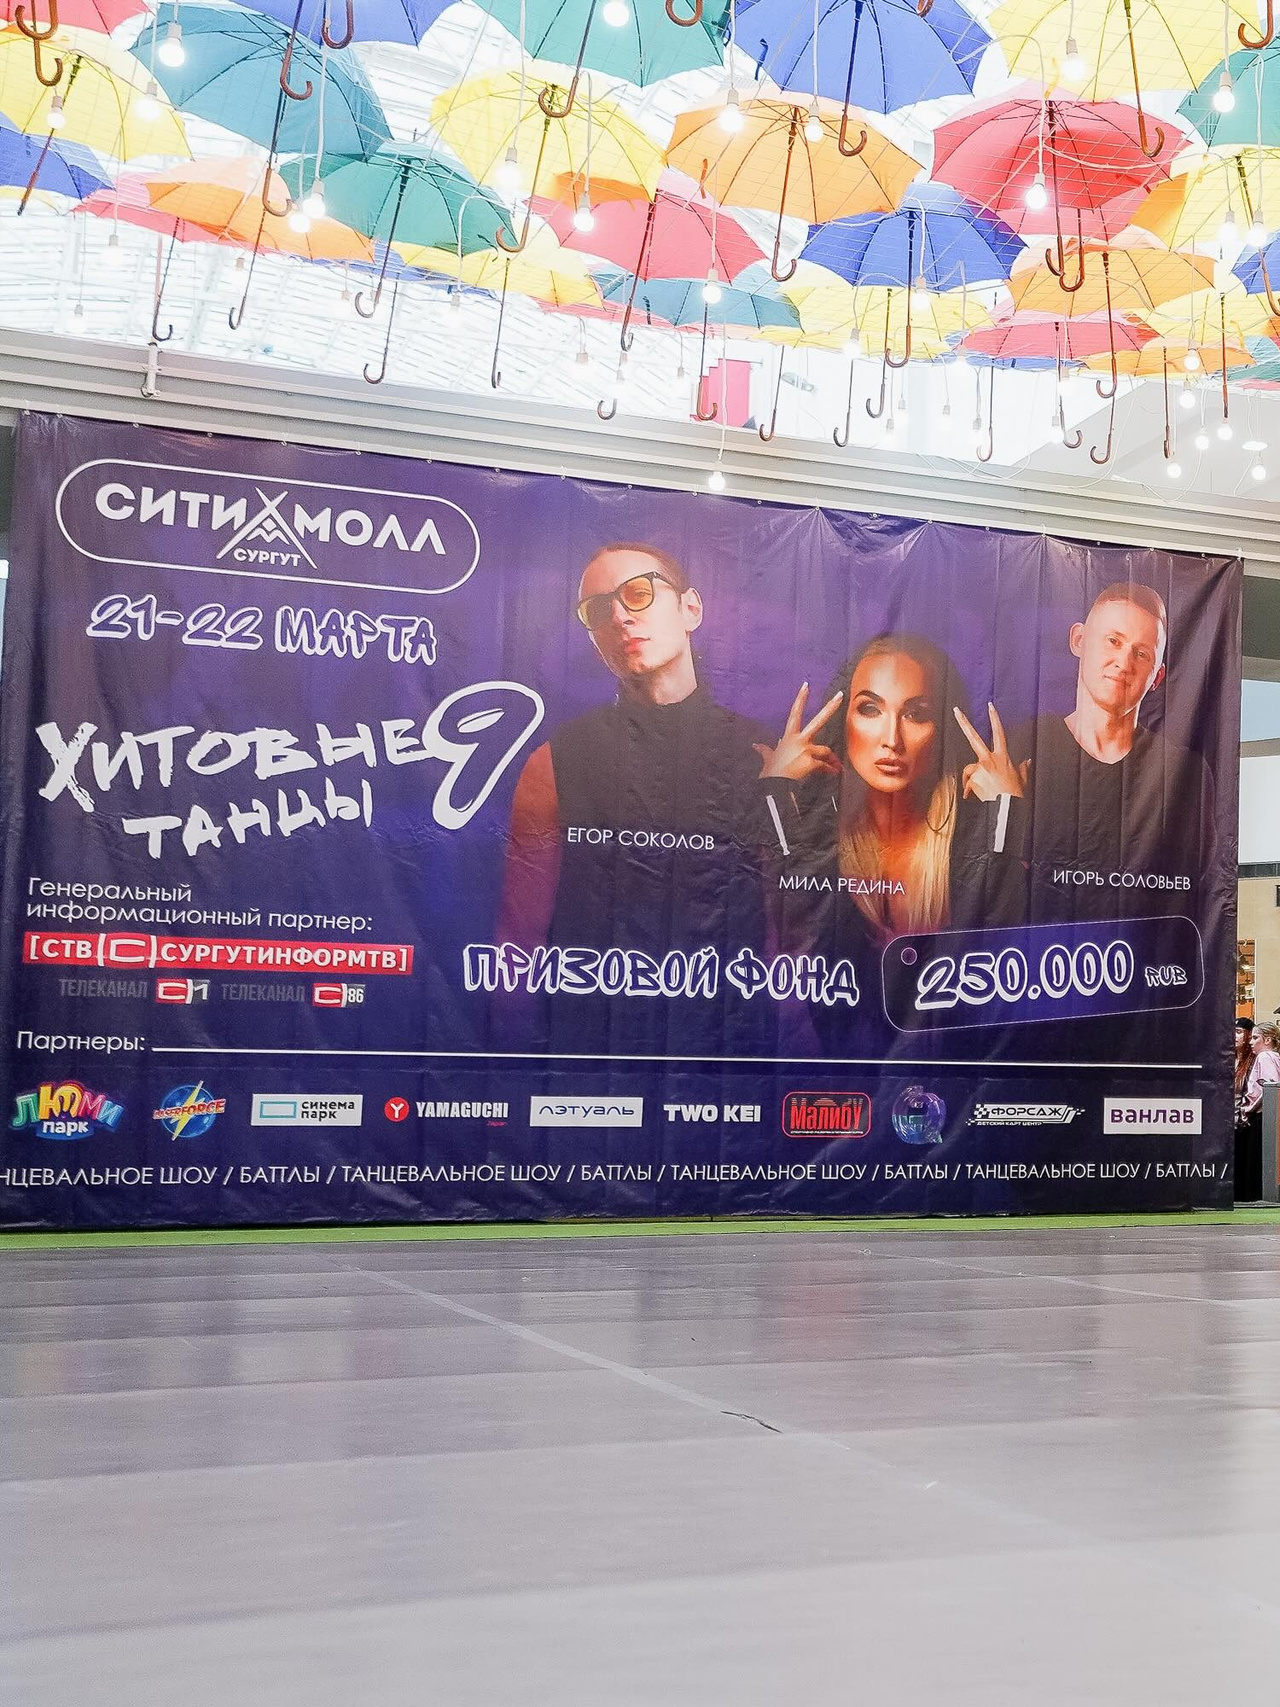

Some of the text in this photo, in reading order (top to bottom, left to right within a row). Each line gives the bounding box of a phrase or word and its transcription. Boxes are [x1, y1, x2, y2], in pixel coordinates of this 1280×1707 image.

[94, 482, 447, 555] СИТИ МОЛЛ
[233, 548, 301, 568] СУРГУТ
[85, 593, 438, 667] 21-22 МАРТА
[566, 827, 715, 850] ЕГОР СОКОЛОВ
[28, 877, 192, 904] Генеральный
[778, 875, 906, 896] МИЛА РЕДИНА
[1053, 869, 1192, 891] ИГОРЬ СОЛОВЬЕВ
[26, 902, 374, 932] информационный партнер:
[462, 941, 861, 1007] ПРИЗОВОЙ ФОНД
[914, 939, 1136, 1011] 250.000
[1144, 965, 1188, 988] RUB
[58, 978, 148, 998] ТЕЛЕКАНАЛ
[220, 983, 305, 1003] ТЕЛЕКАНАЛ
[16, 1030, 146, 1053] Партнеры:
[300, 1109, 338, 1122] парк
[301, 1100, 355, 1111] синема
[415, 1101, 509, 1118] YAMAGUCHI
[663, 1104, 762, 1122] TWO KEI
[991, 1107, 1063, 1116] ФОРСАЖ
[1110, 1108, 1195, 1125] ванлав
[41, 1121, 89, 1137] парк
[160, 1167, 217, 1184] ШОУ
[240, 1166, 320, 1183] БАТТЛЫ
[342, 1165, 505, 1184] ТАНЦЕВАЛЬНОЕ
[510, 1165, 561, 1181] ШОУ
[581, 1165, 652, 1181] БАТТЛЫ
[671, 1164, 816, 1182] ТАНЦЕВАЛЬНОЕ
[821, 1165, 867, 1180] ШОУ
[884, 1165, 948, 1180] БАТТЛЫ
[966, 1164, 1096, 1180] ТАНЦЕВАЛЬНОЕ
[1100, 1164, 1140, 1179] ШОУ
[1156, 1163, 1215, 1179] БАТТЛЫ
